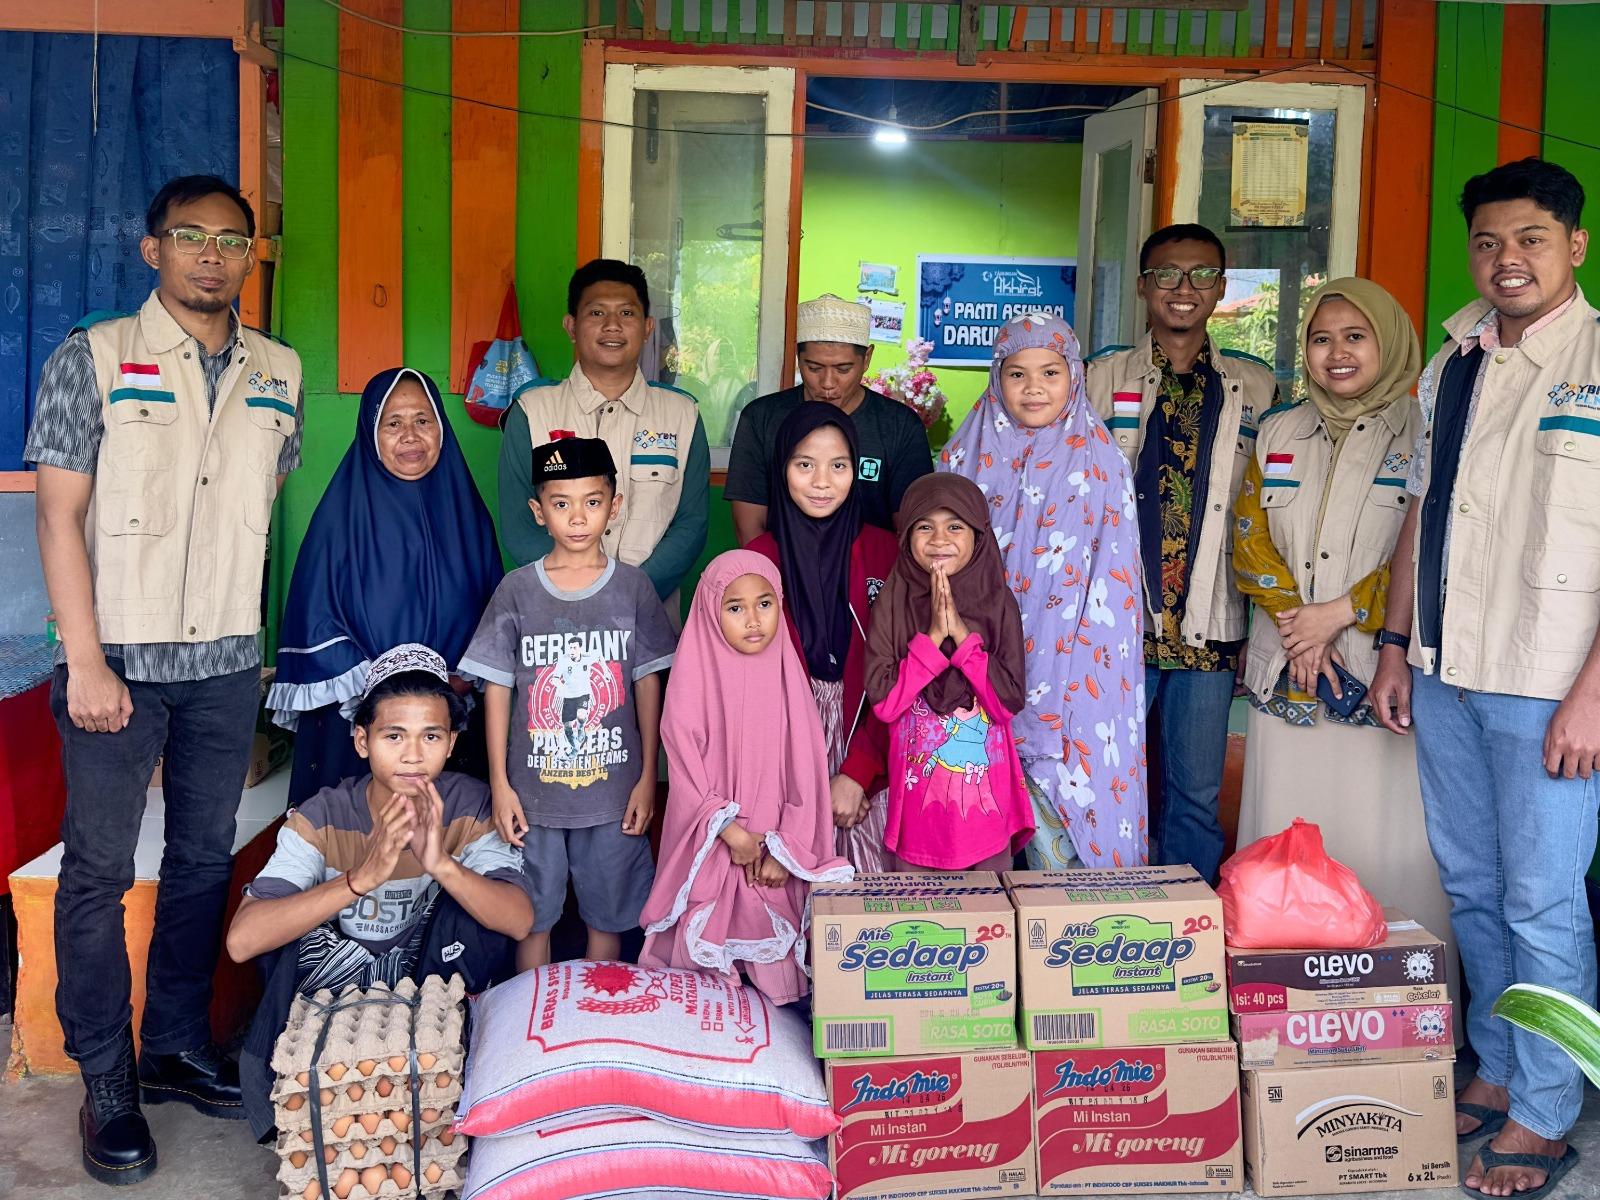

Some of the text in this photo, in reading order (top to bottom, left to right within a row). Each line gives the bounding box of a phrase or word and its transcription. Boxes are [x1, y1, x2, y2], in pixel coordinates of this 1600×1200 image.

[955, 303, 997, 320] PANTI
[544, 463, 567, 472] adidas
[596, 749, 629, 766] TEAMS
[1063, 923, 1099, 938] Mie
[1182, 915, 1212, 935] 20
[858, 929, 892, 943] Mie
[975, 923, 1005, 943] 20
[839, 938, 988, 973] Sedaap
[1044, 934, 1195, 968] Sedaap
[906, 971, 954, 984] Instant
[1113, 966, 1162, 978] Instant
[669, 972, 683, 1003] SUPER
[870, 990, 891, 999] JELAS
[924, 989, 962, 997] SEDAPNYA
[1078, 987, 1099, 995] JELAS
[1132, 984, 1170, 992] SEDAPNYA
[1253, 992, 1264, 1005] 40
[1267, 994, 1284, 1007] pcs
[1407, 990, 1440, 1002] Cokelat
[541, 989, 559, 1031] BERAS
[931, 1023, 1012, 1040] RASA SOTO
[1139, 1016, 1221, 1033] RASA SOTO
[974, 1055, 1000, 1063] GUNAKAN
[1268, 1089, 1283, 1099] SNI
[1073, 1111, 1130, 1123] Mi Instan
[870, 1122, 927, 1137] Mi Instan
[1315, 1112, 1402, 1138] MINYAKITA
[1072, 1132, 1205, 1159] Mi goreng
[1344, 1146, 1398, 1157] sinarmas
[869, 1142, 999, 1168] Mi goreng
[1430, 1161, 1450, 1169] Bersih
[1407, 1172, 1414, 1182] 6
[1424, 1171, 1435, 1181] 2L
